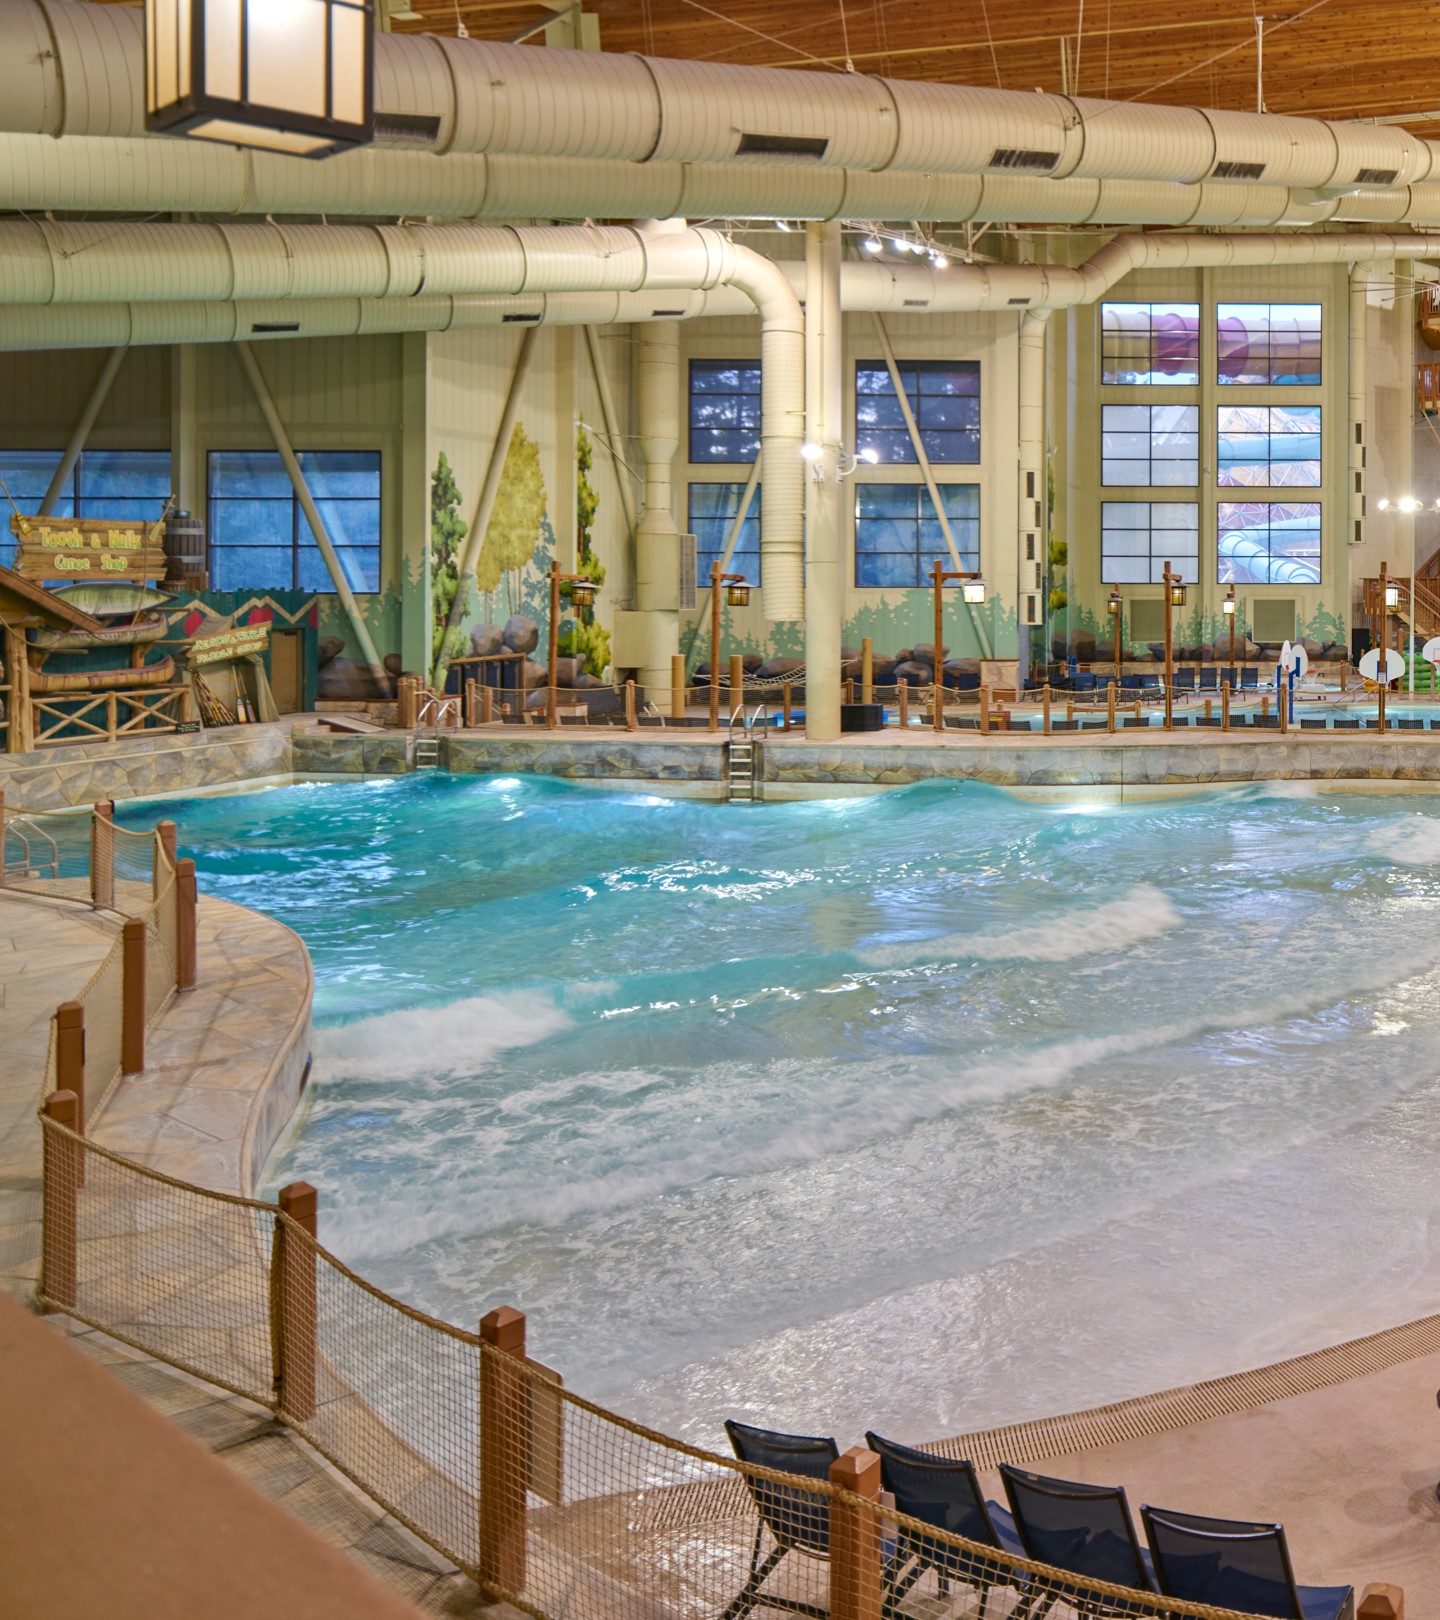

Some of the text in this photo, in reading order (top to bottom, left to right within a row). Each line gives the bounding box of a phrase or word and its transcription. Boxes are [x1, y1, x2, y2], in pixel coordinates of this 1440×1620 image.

[39, 527, 141, 550] Tooth & Nails
[55, 554, 90, 570] Canoe
